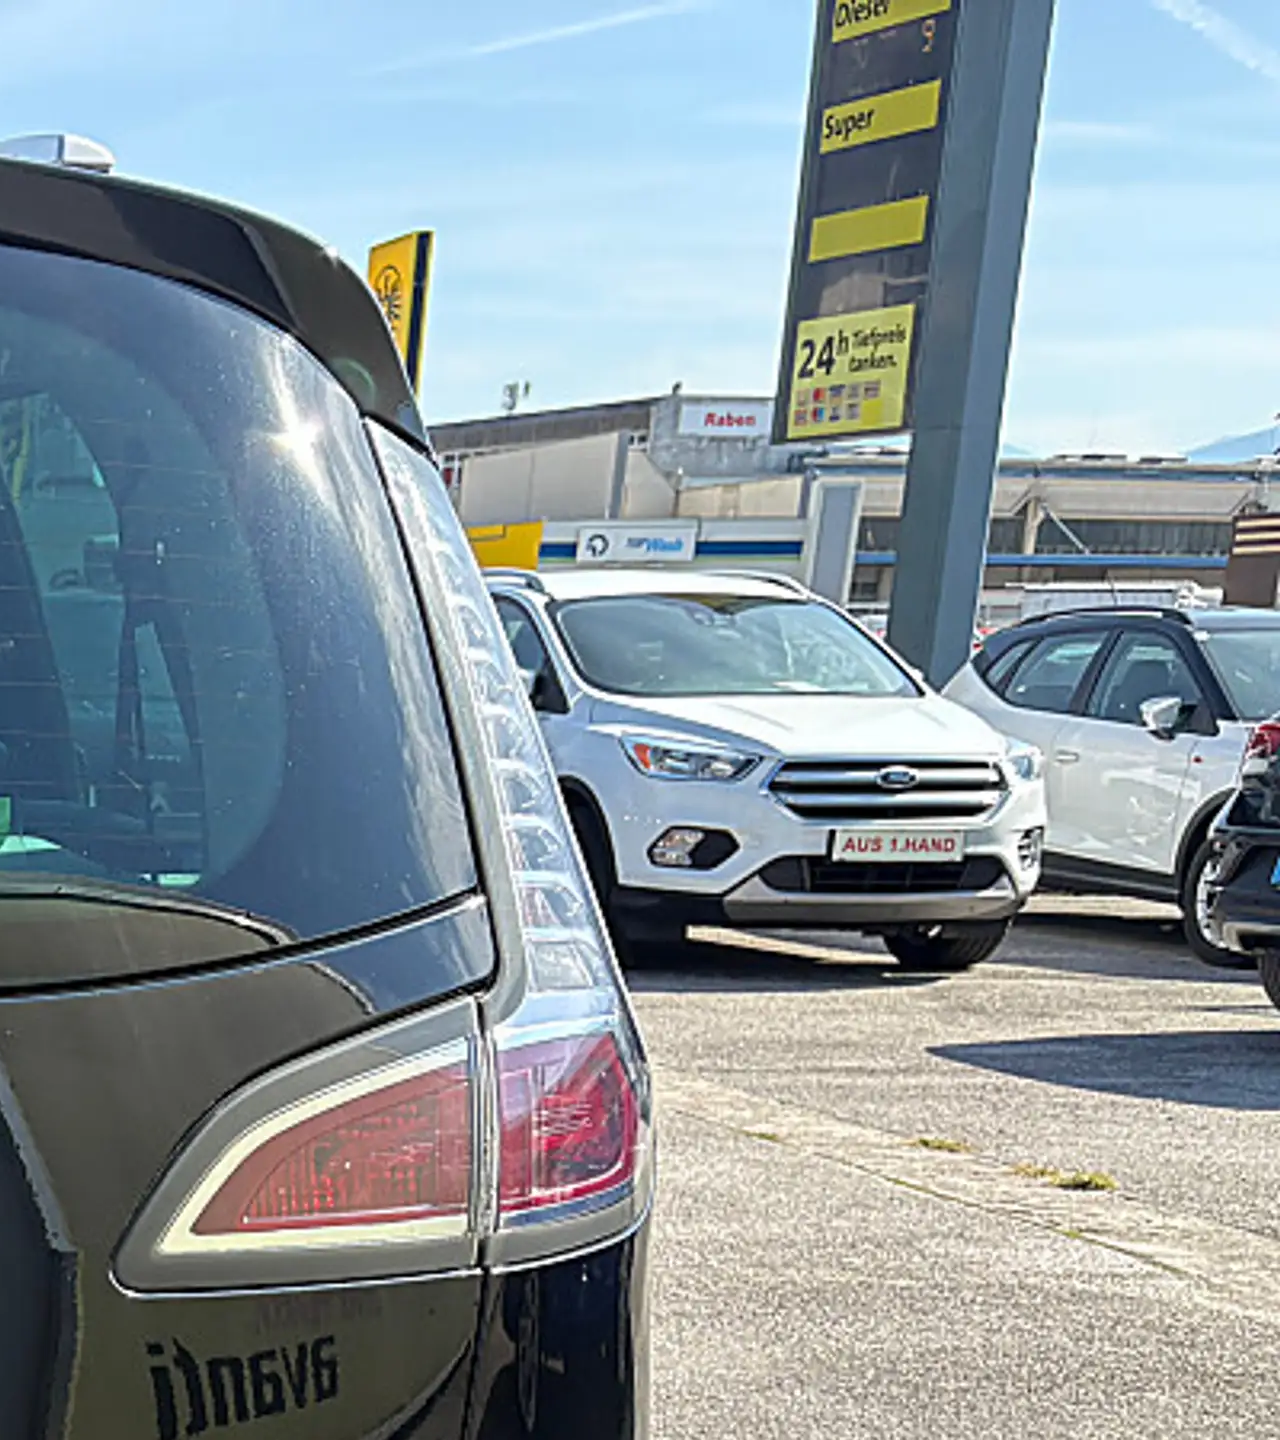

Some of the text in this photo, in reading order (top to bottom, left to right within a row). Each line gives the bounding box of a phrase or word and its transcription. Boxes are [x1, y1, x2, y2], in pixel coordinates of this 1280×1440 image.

[825, 109, 874, 141] Super
[705, 411, 757, 427] Raben
[842, 837, 883, 853] AUS
